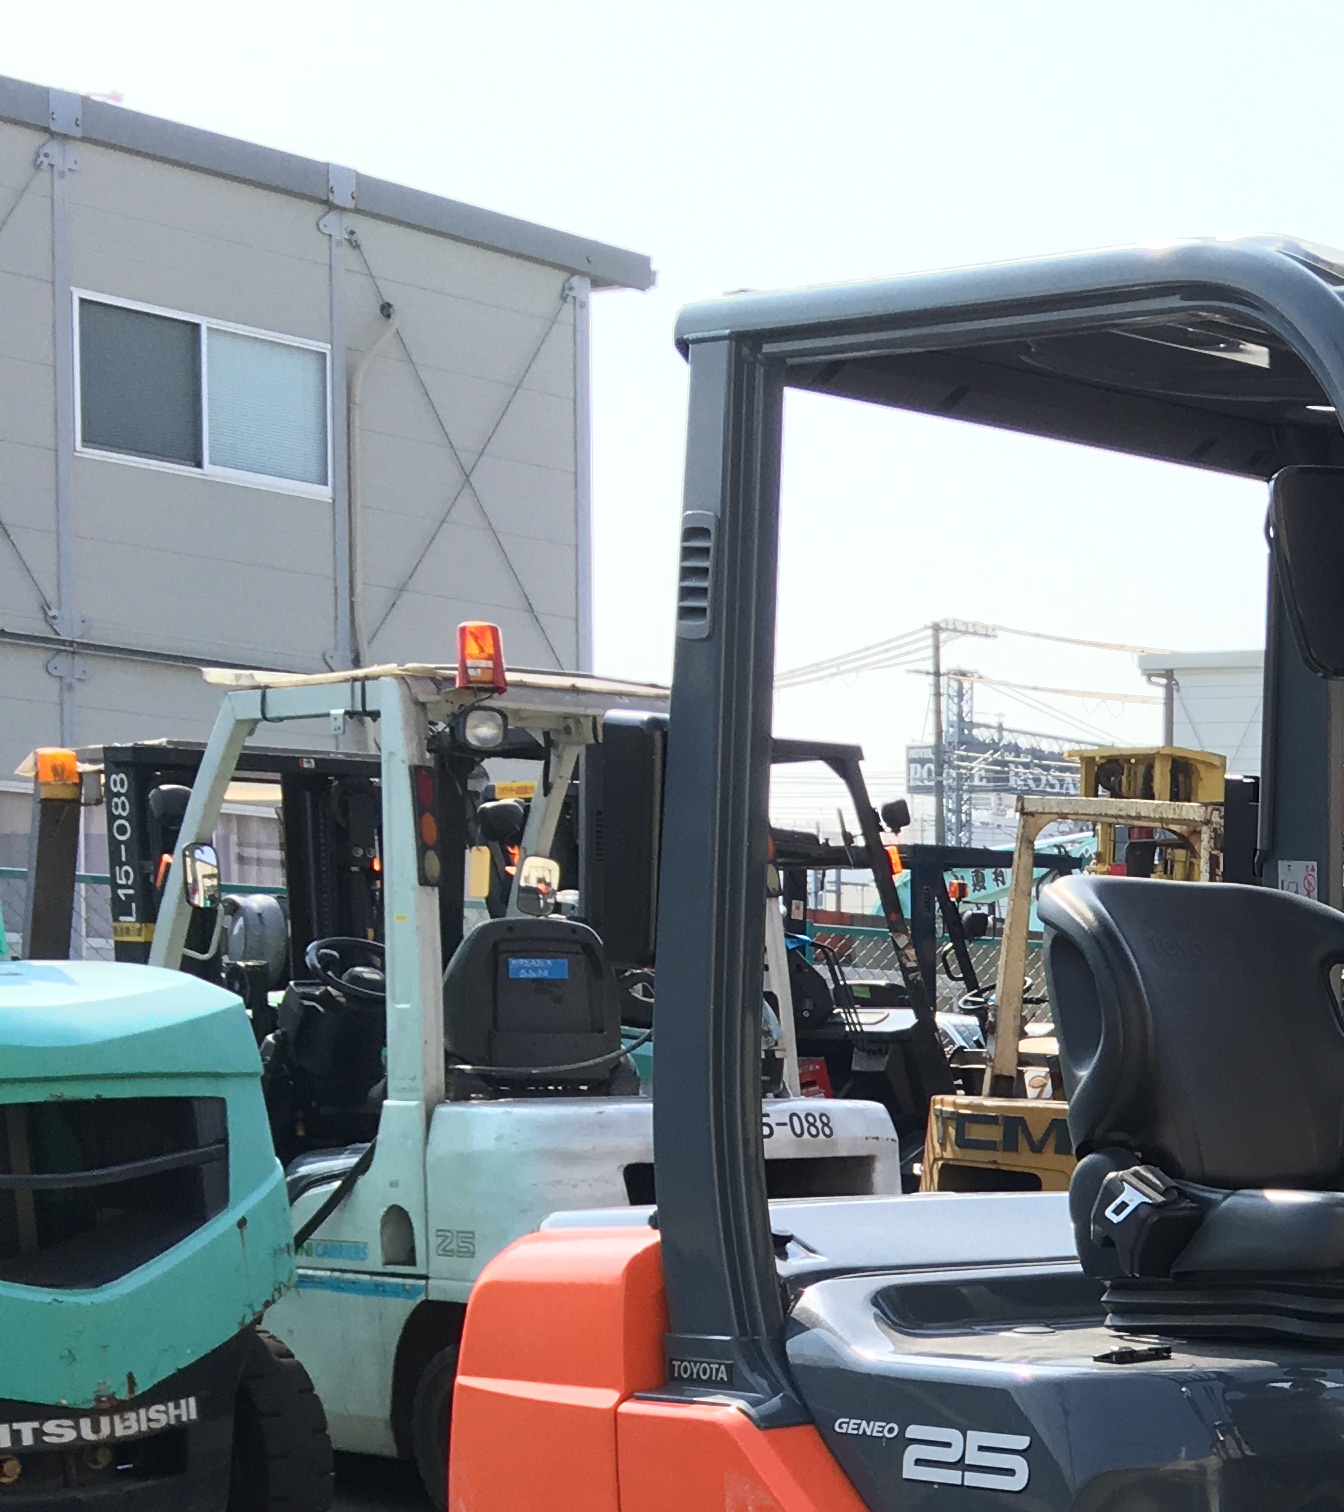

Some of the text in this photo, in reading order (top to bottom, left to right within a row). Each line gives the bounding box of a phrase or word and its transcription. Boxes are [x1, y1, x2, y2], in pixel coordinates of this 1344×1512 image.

[110, 773, 136, 922] L15-088
[435, 1229, 476, 1259] 25
[672, 1361, 728, 1382] TOYOTA
[0, 1396, 198, 1448] ITSUBISHI
[834, 1418, 1031, 1492] GENEO 25
